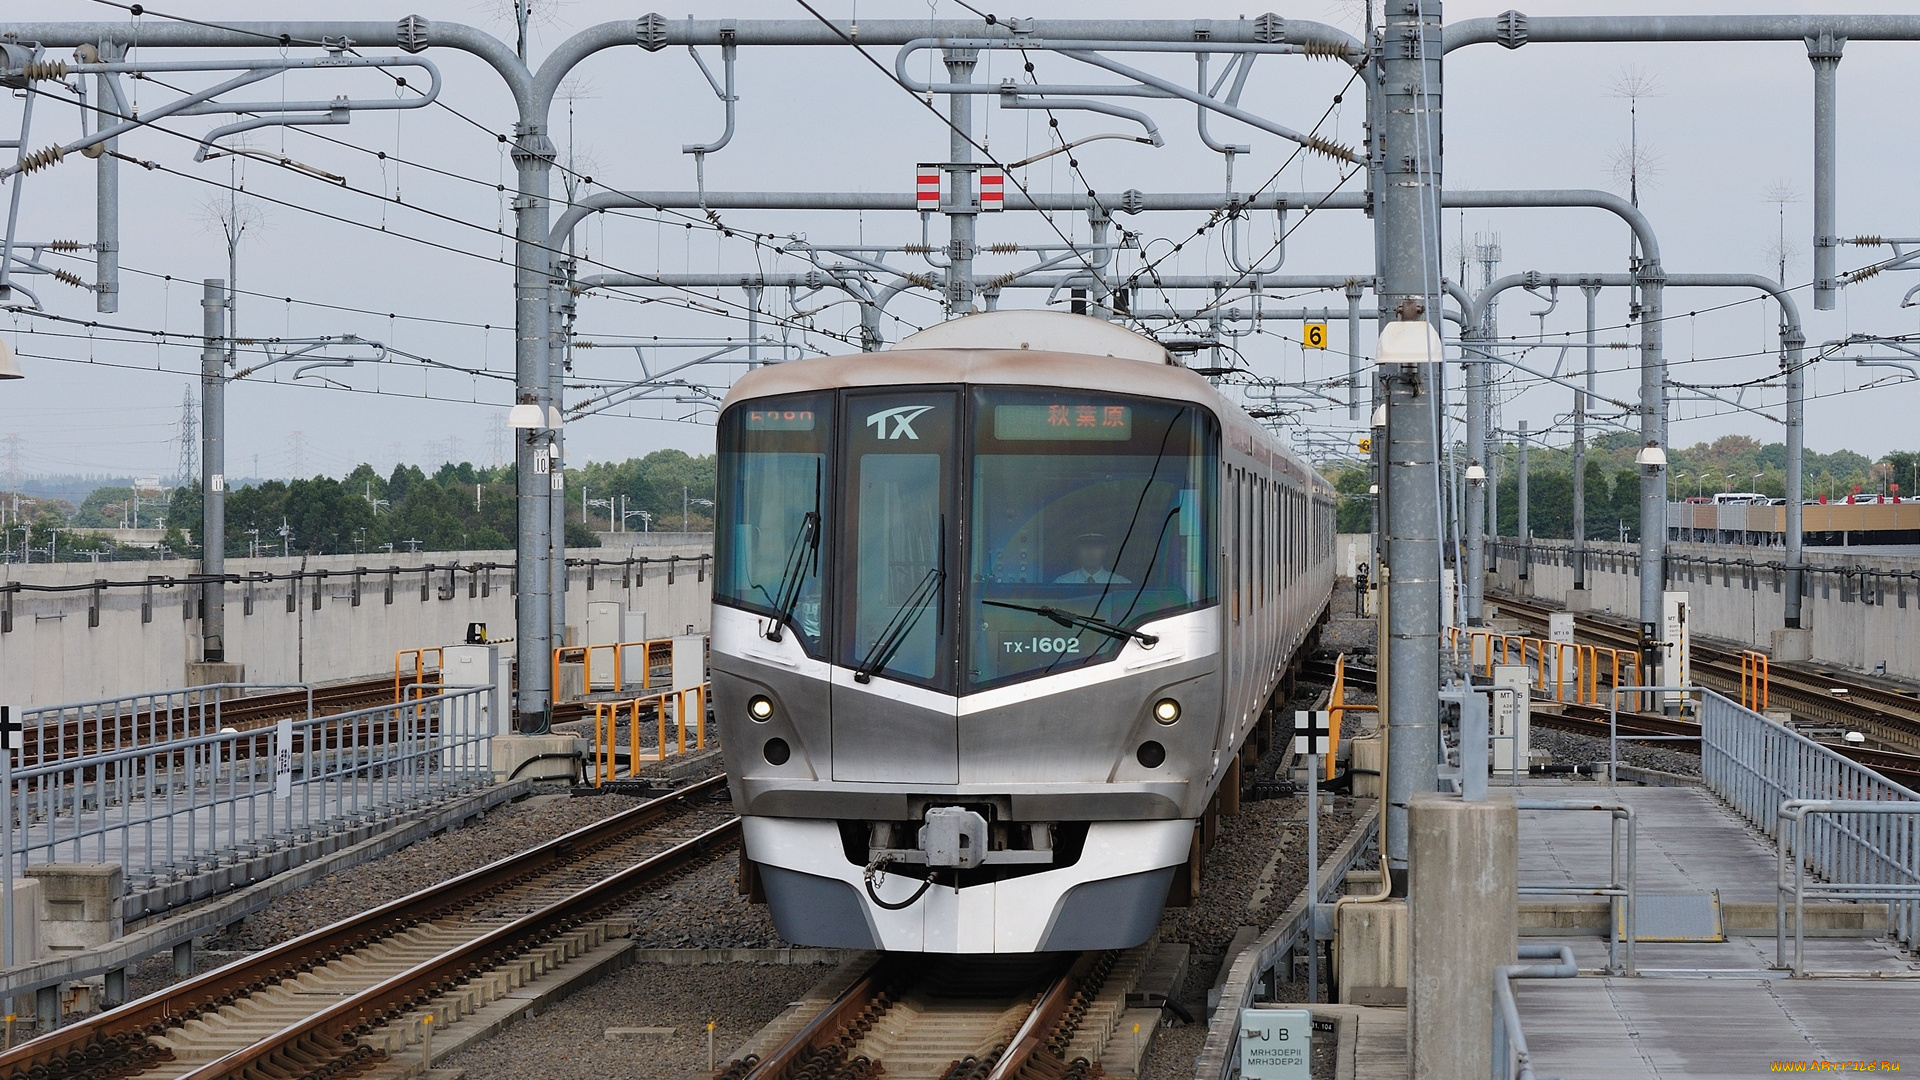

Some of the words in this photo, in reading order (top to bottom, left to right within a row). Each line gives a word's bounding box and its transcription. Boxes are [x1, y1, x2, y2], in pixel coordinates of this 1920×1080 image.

[1309, 326, 1322, 346] 6
[867, 405, 936, 439] TX
[1047, 405, 1125, 427] 秋葉原
[1003, 637, 1080, 653] TX-1602
